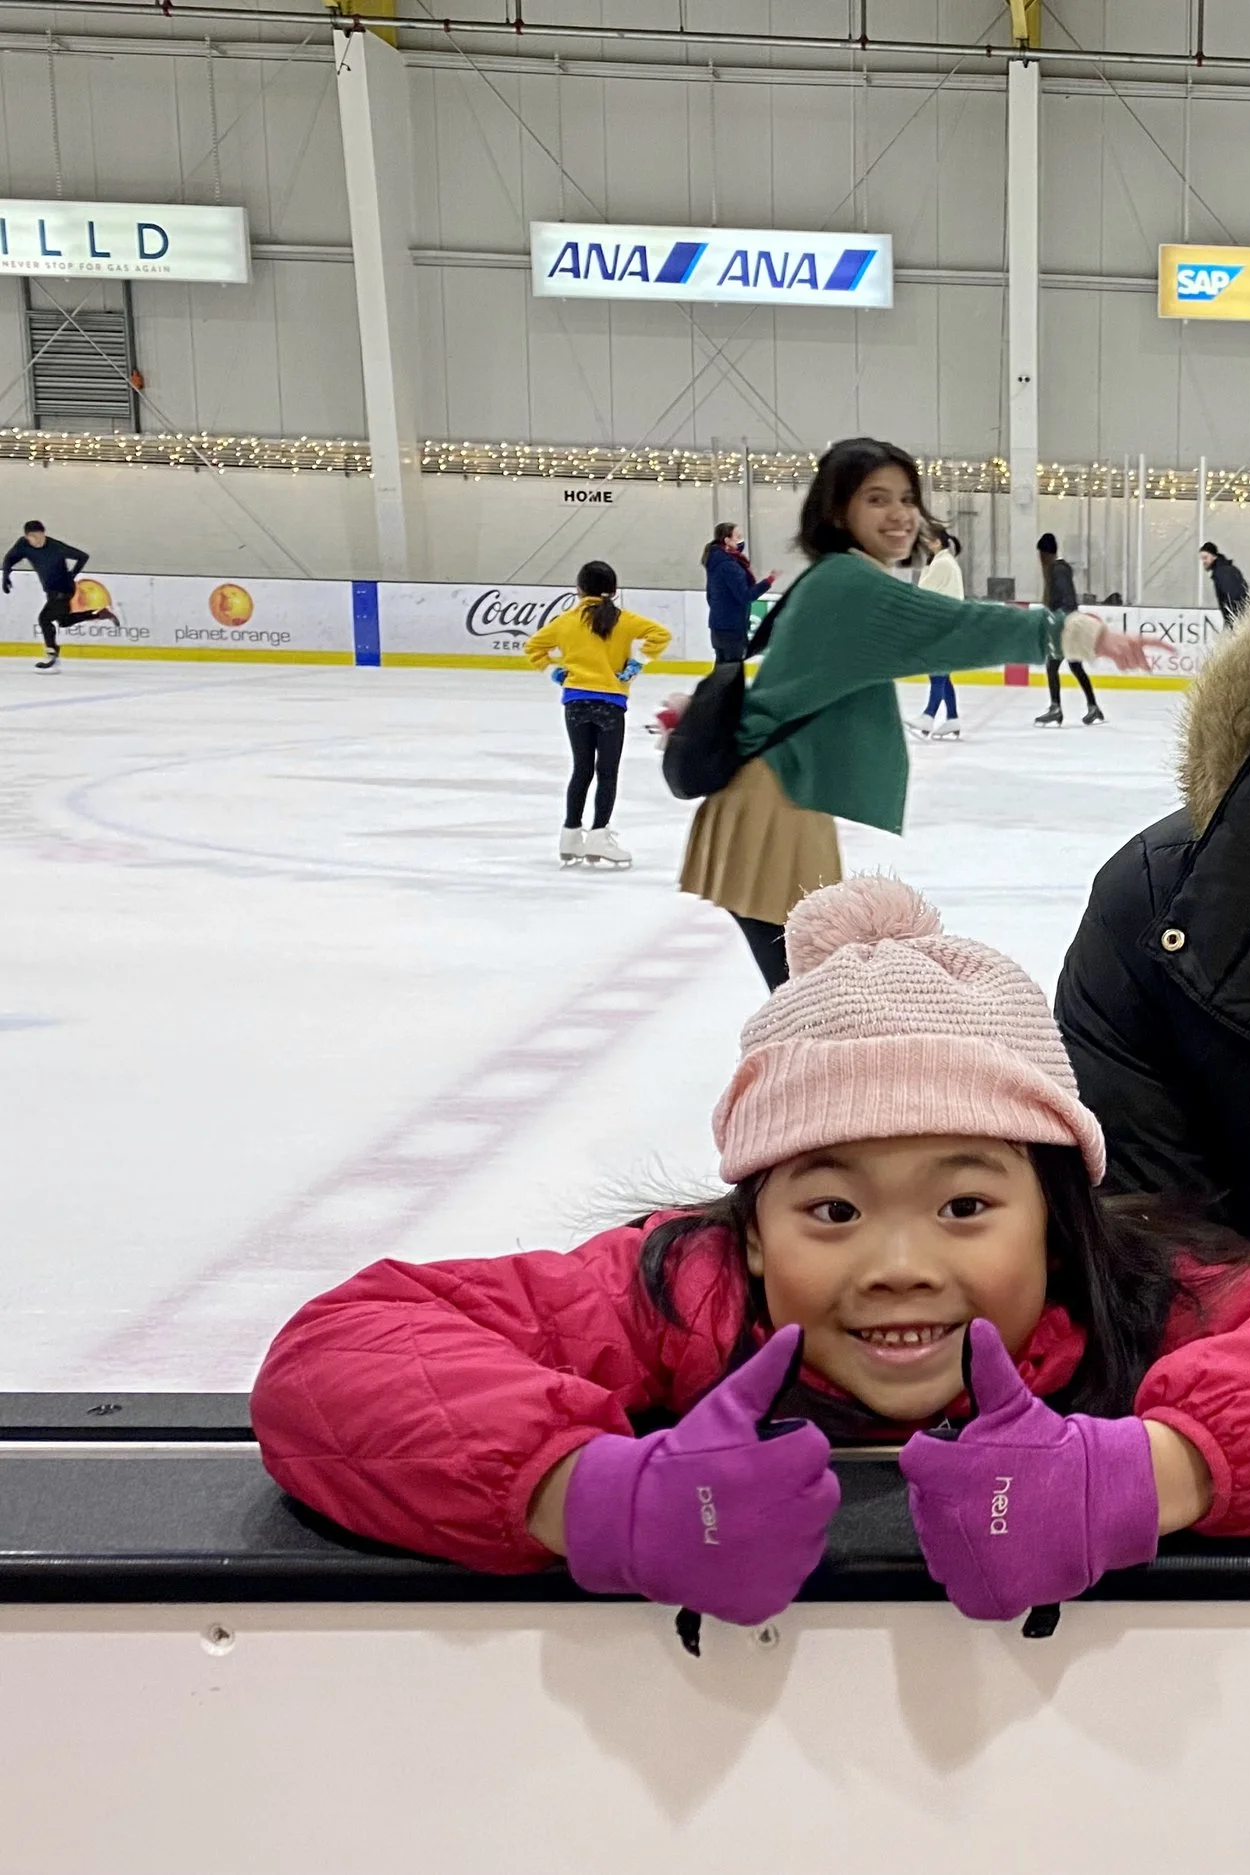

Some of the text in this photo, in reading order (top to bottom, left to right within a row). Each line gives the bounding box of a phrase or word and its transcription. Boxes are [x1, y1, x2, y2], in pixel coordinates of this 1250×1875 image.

[2, 261, 171, 273] NEVER STOP FOR GAS AGAIN
[548, 241, 818, 290] ANA ANA
[1178, 269, 1231, 296] SAP
[564, 490, 613, 503] HOME
[466, 589, 579, 637] Coca-C
[33, 623, 150, 642] pnet orange
[175, 625, 291, 646] planet orange
[1123, 612, 1220, 645] LexisN
[695, 1486, 720, 1545] head
[990, 1476, 1014, 1535] head
